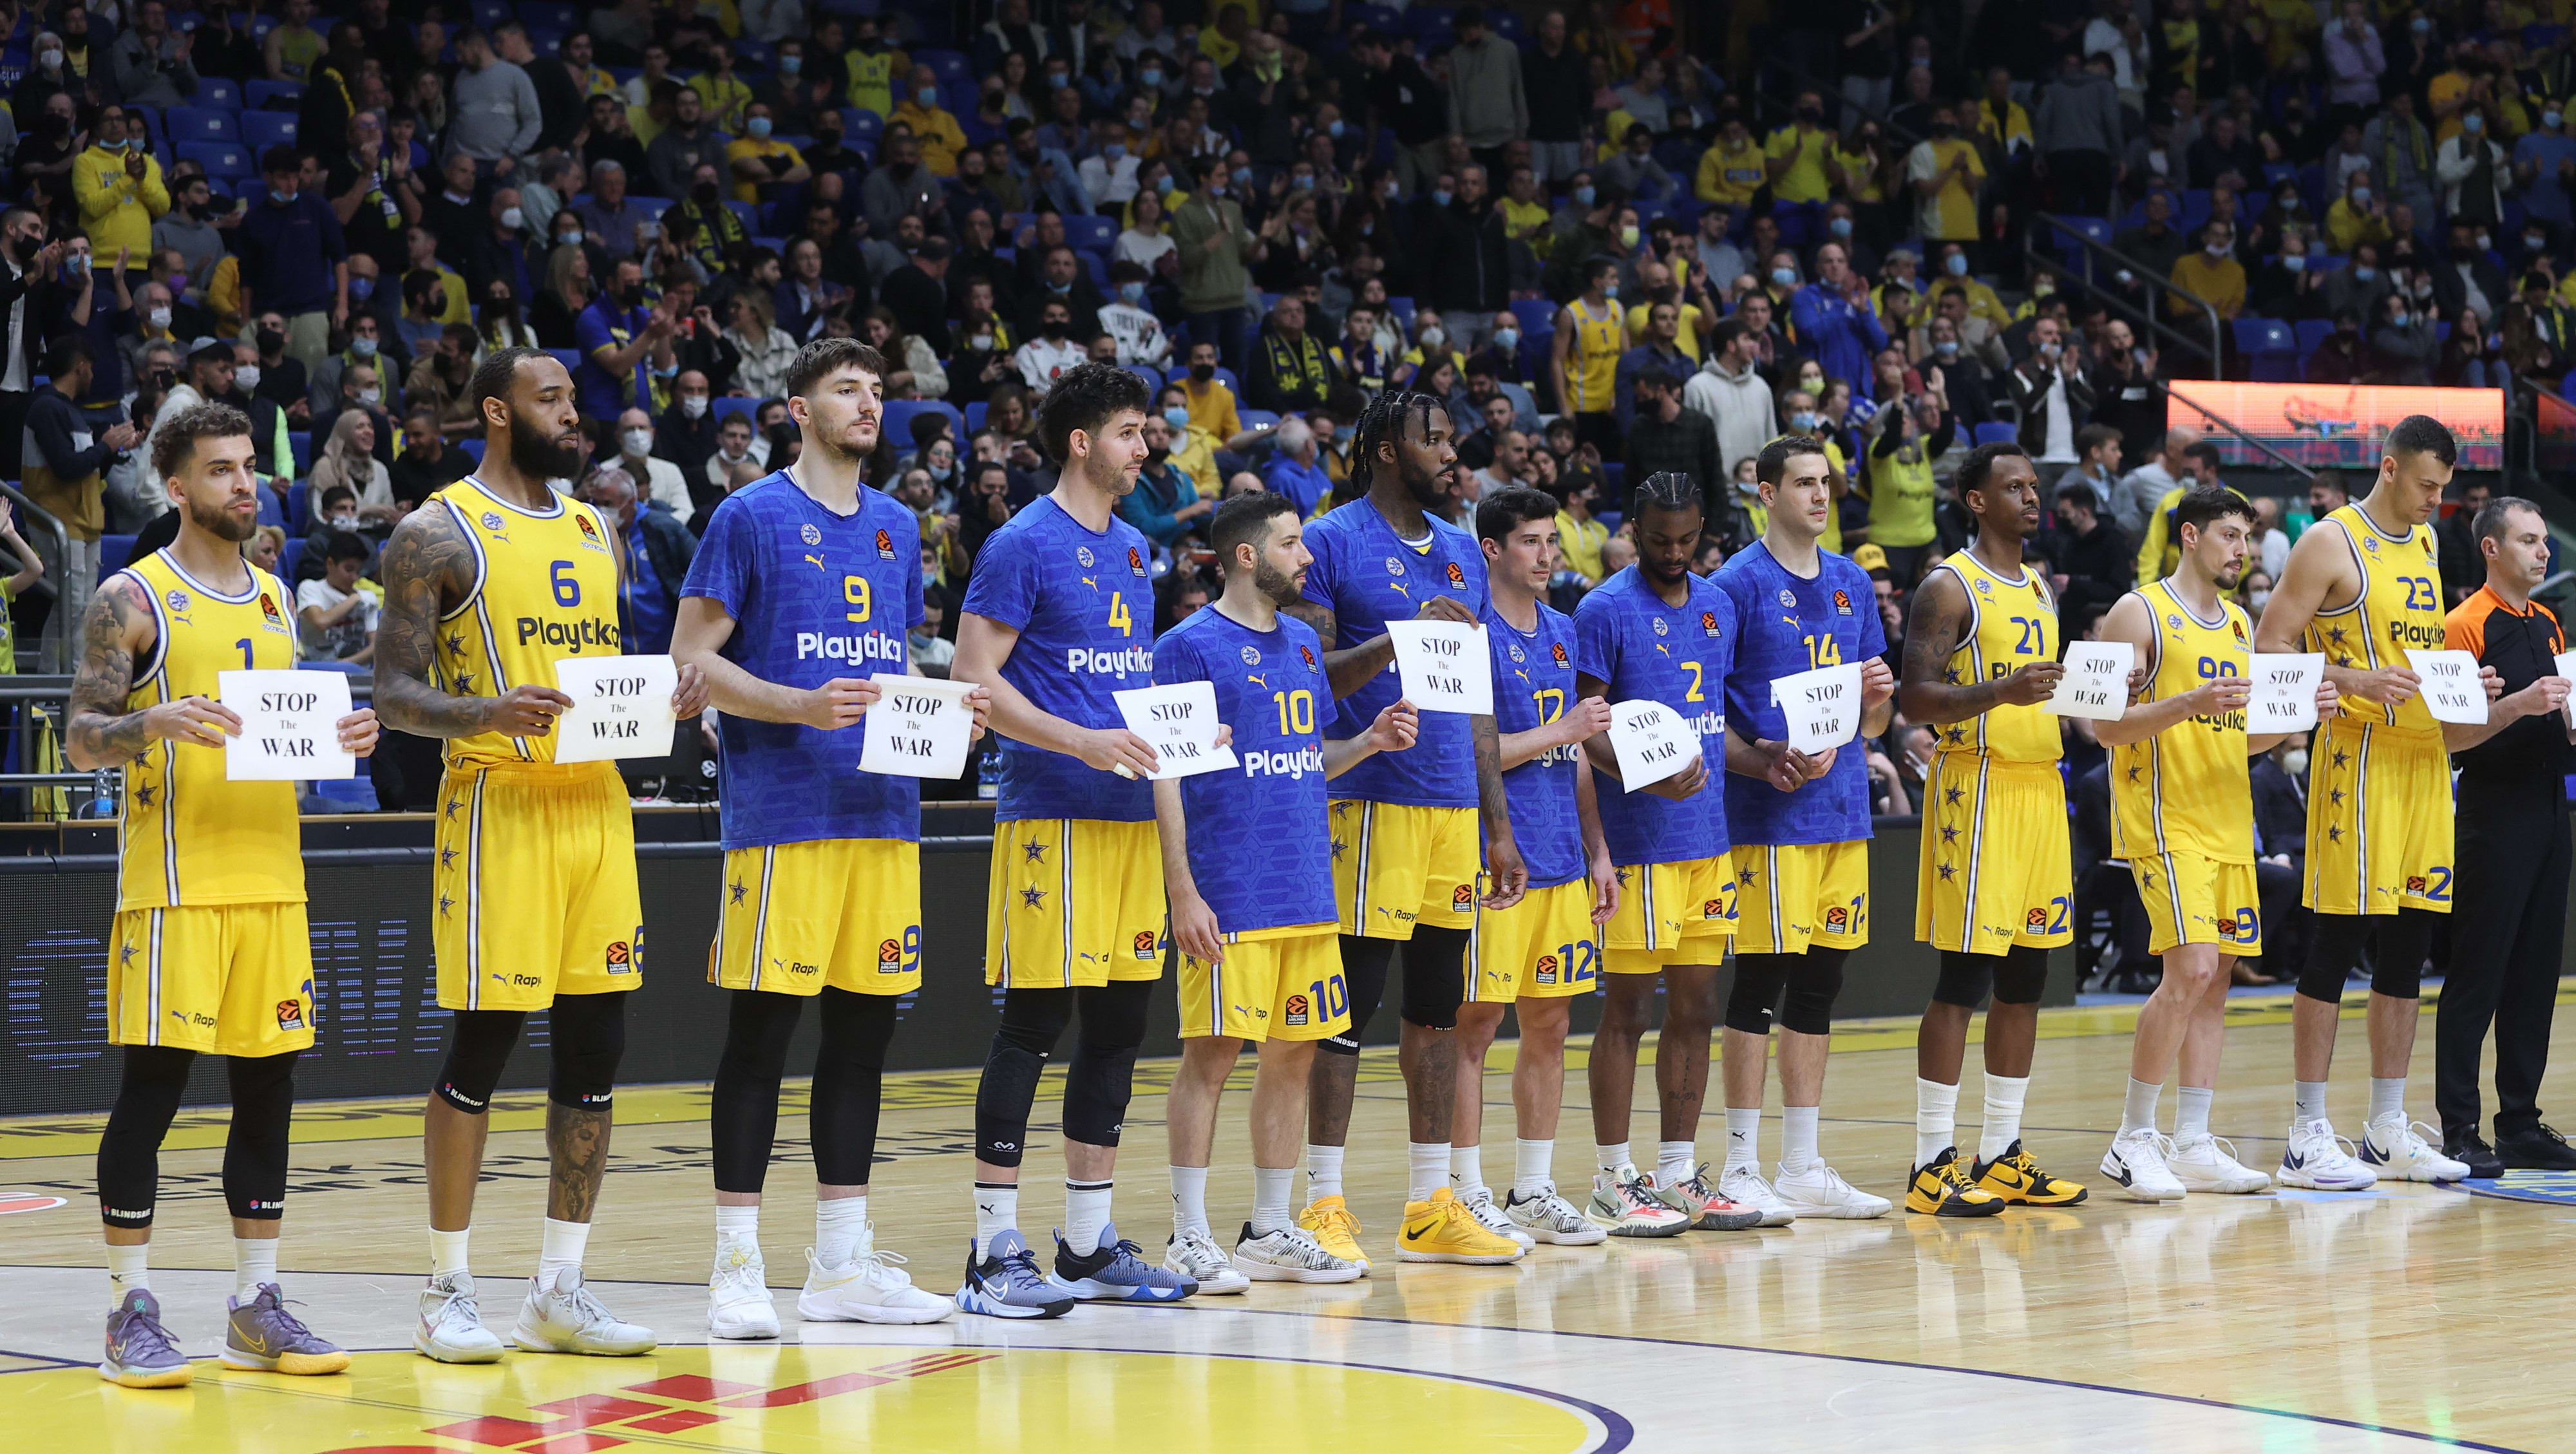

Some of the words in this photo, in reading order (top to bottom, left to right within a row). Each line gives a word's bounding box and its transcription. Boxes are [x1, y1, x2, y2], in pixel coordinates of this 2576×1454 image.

[549, 560, 581, 607] 6
[844, 575, 871, 623] 9
[2396, 576, 2437, 611] 23
[1108, 591, 1132, 637] 4
[2010, 616, 2044, 656] 21
[236, 638, 254, 670] 1
[1421, 638, 1461, 656] STOP
[1803, 633, 1842, 670] 14
[1438, 661, 1449, 670] The
[2084, 659, 2116, 674] STOP
[2430, 663, 2461, 677] STOP
[1426, 674, 1463, 694] WAR
[1680, 661, 1705, 703] 2
[2269, 670, 2304, 684] STOP
[594, 677, 646, 697] STOP
[1805, 684, 1842, 703] STOP
[261, 693, 317, 712] STOP
[892, 695, 942, 715] STOP
[2075, 690, 2107, 706] WAR
[2437, 694, 2468, 707] WAR
[611, 704, 627, 713] The
[1150, 702, 1193, 721] STOP
[1273, 689, 1314, 735] 10
[1821, 706, 1831, 715] The
[2267, 702, 2297, 716] WAR
[279, 719, 296, 730] The
[592, 720, 639, 739] WAR
[907, 721, 921, 730] The
[1627, 710, 1661, 732] STOP
[1810, 718, 1839, 736] WAR
[1169, 727, 1182, 736] The
[1647, 733, 1659, 741] The
[261, 738, 315, 757] WAR
[891, 735, 933, 757] WAR
[1160, 742, 1200, 759] WAR
[1641, 741, 1677, 764] WAR
[2425, 866, 2452, 901] 2
[1721, 881, 1739, 920] 2
[902, 925, 922, 972] 9
[1558, 939, 1595, 983] 12
[1309, 974, 1349, 1023] 10
